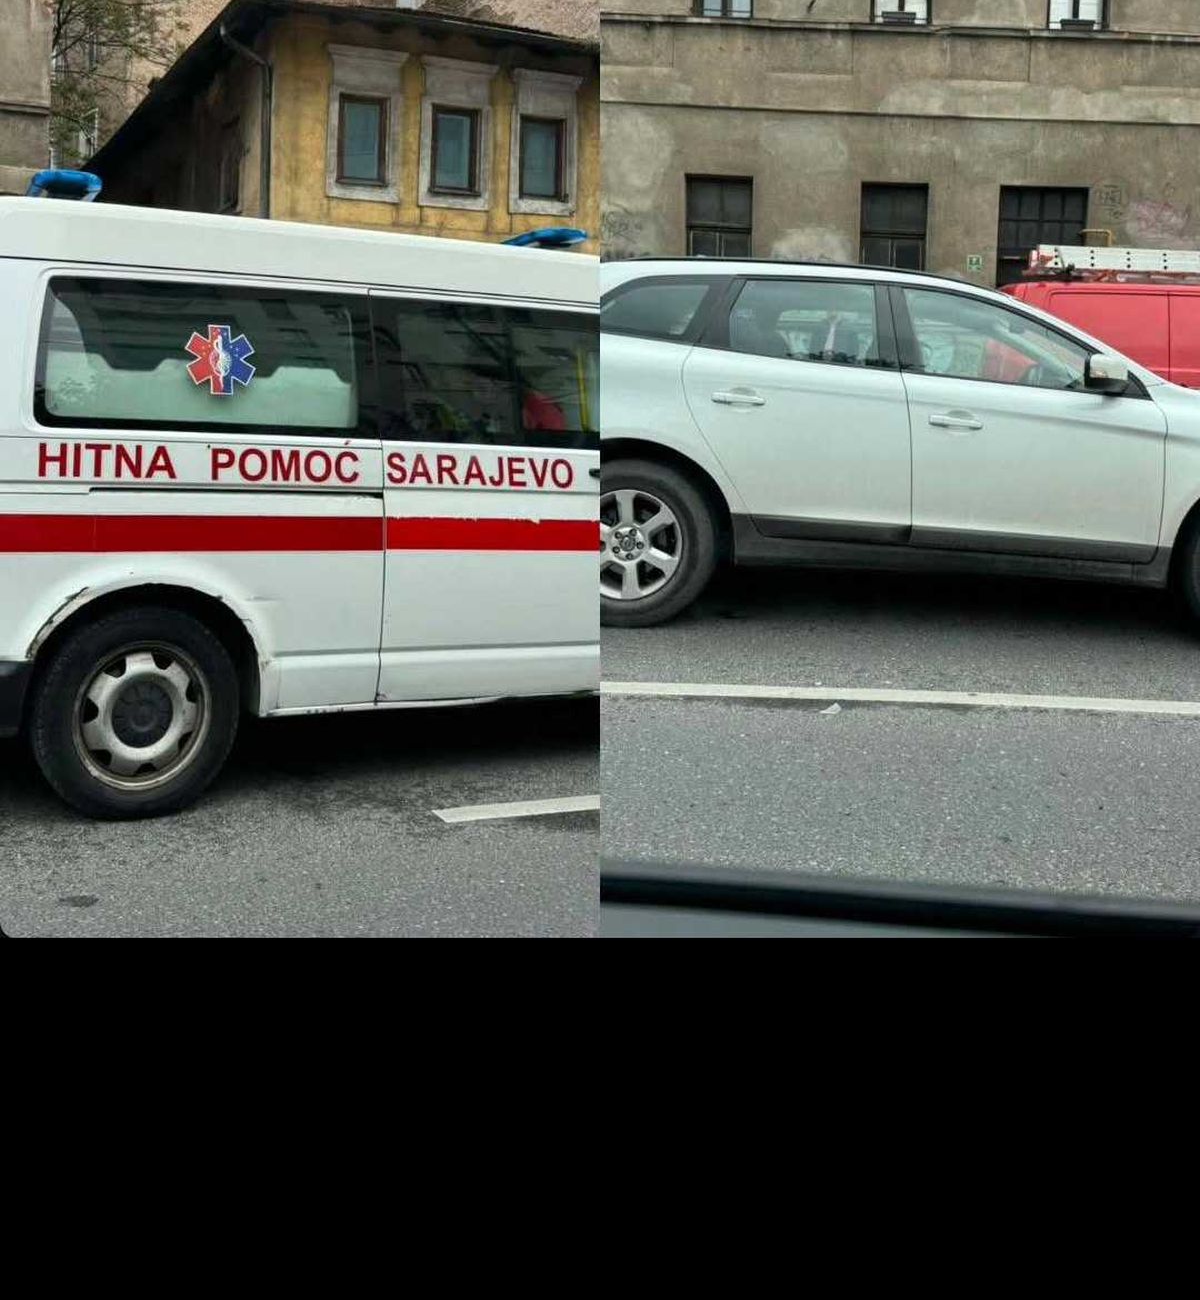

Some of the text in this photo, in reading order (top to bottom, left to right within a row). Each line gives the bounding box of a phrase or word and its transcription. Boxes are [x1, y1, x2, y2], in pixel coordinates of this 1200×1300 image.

[38, 439, 574, 489] HITNA POMOĆ SARAJEVO
